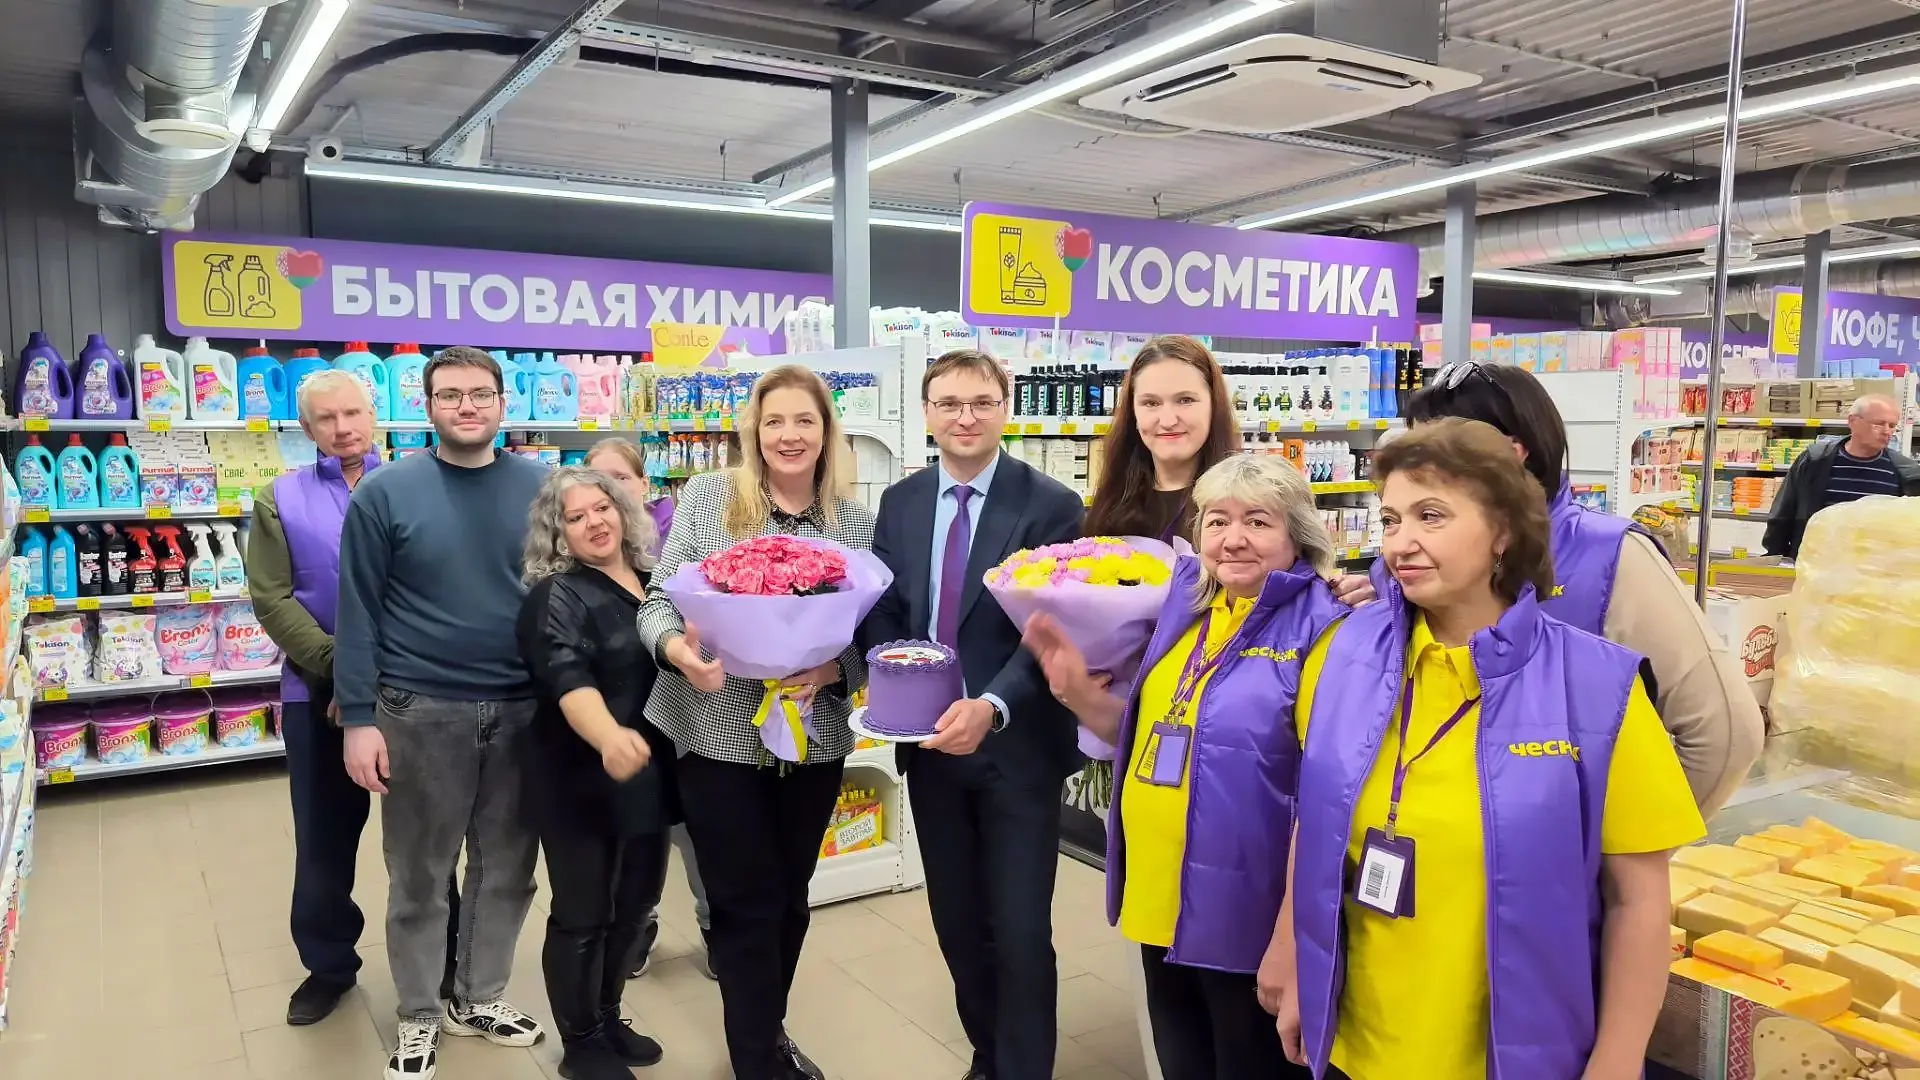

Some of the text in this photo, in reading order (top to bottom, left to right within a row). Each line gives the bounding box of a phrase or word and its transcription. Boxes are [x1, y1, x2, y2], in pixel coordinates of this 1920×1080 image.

[1096, 243, 1399, 318] КОСМЕТИКА
[331, 264, 826, 334] БЫТОВАЯ ХИМИ
[653, 327, 710, 348] Conte
[1830, 307, 1904, 356] КОФЕ,
[160, 624, 210, 644] Bronx
[224, 625, 267, 640] Bron
[161, 726, 199, 740] Bronx
[218, 717, 252, 732] Bronx
[99, 733, 138, 748] Bronx
